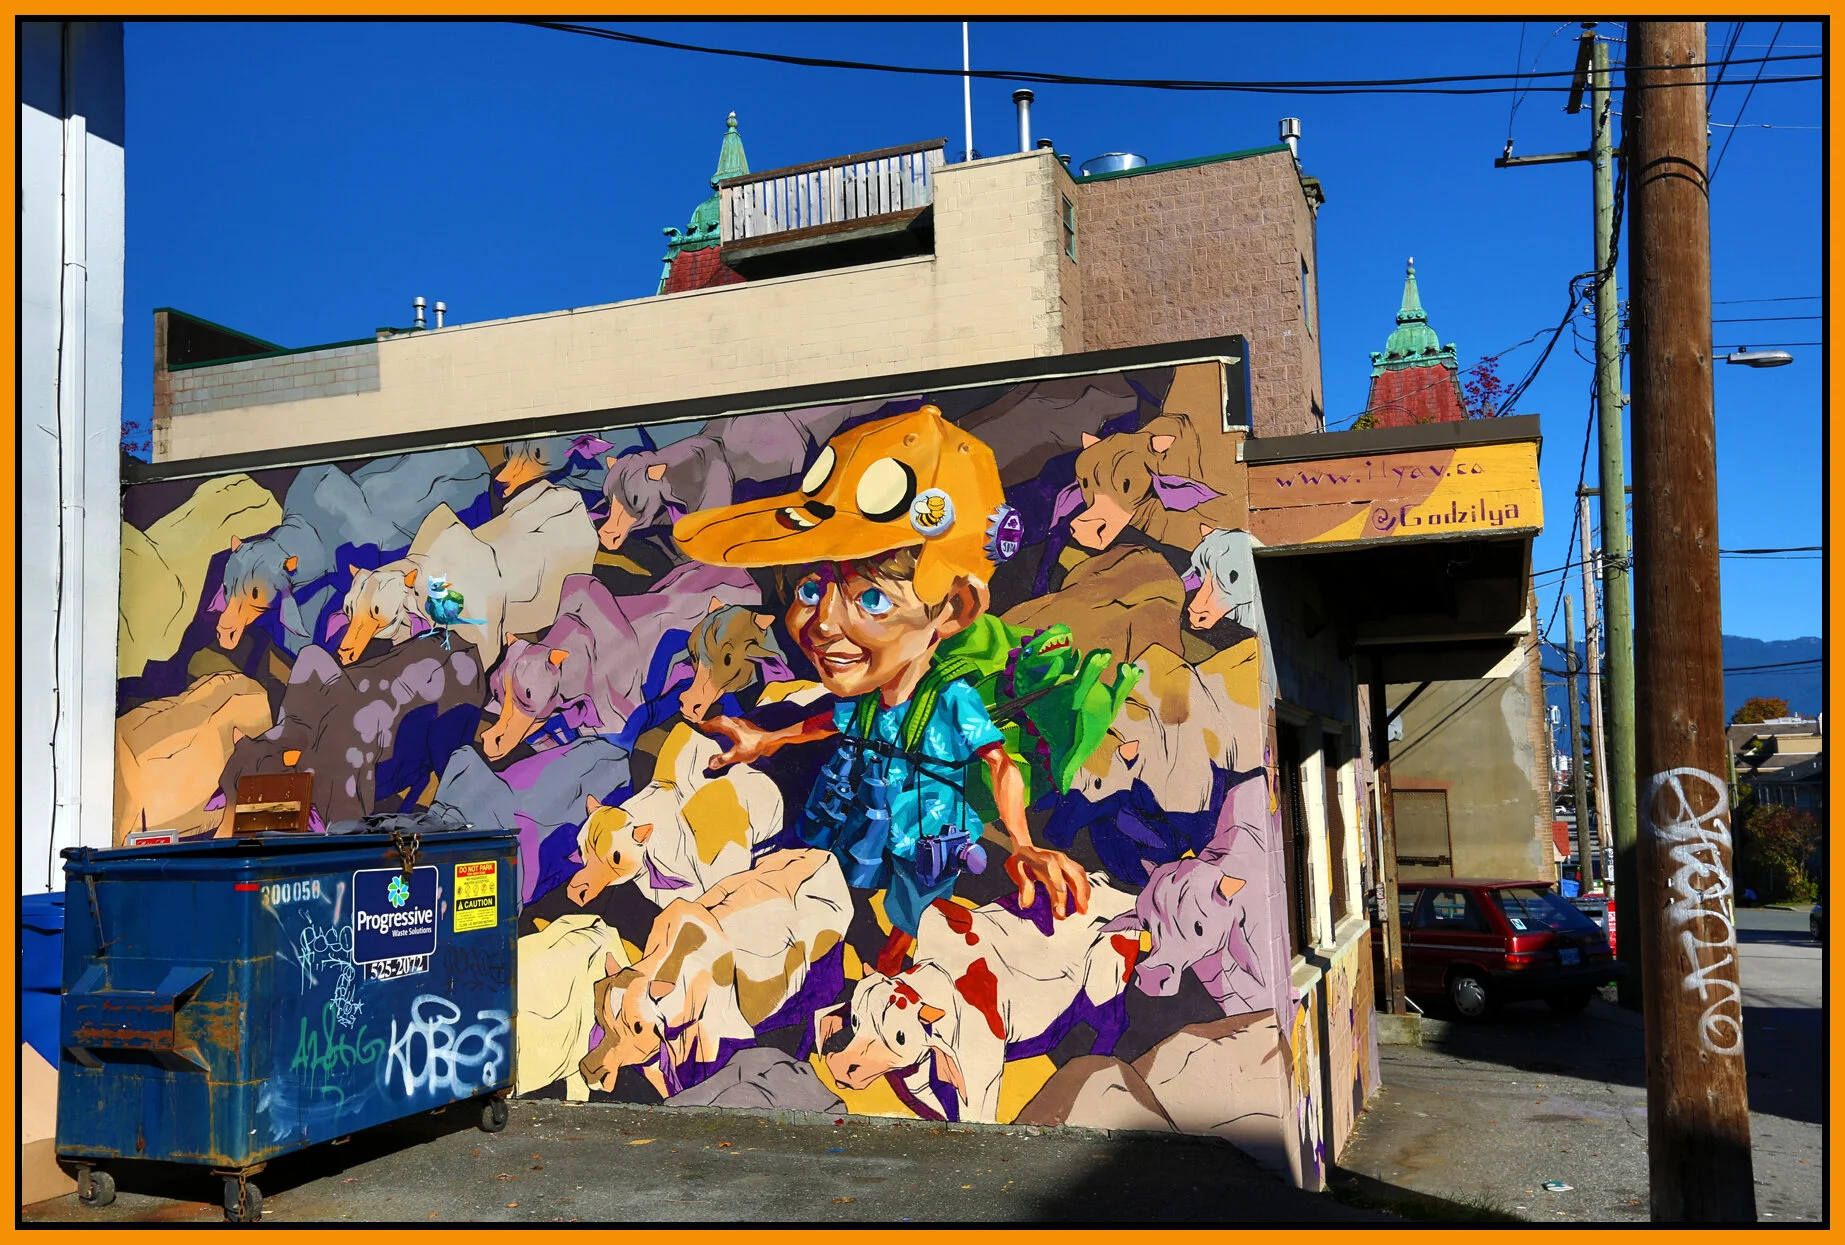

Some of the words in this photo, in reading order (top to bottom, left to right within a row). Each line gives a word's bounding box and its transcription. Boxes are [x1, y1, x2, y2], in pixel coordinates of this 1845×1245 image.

[1275, 460, 1485, 488] www.ilyav.ca
[468, 865, 478, 873] NOT
[464, 898, 493, 908] CAUTION
[357, 906, 433, 934] Progressive
[392, 928, 408, 938] Waste
[408, 926, 432, 936] Solutions
[370, 955, 423, 980] 525-2072
